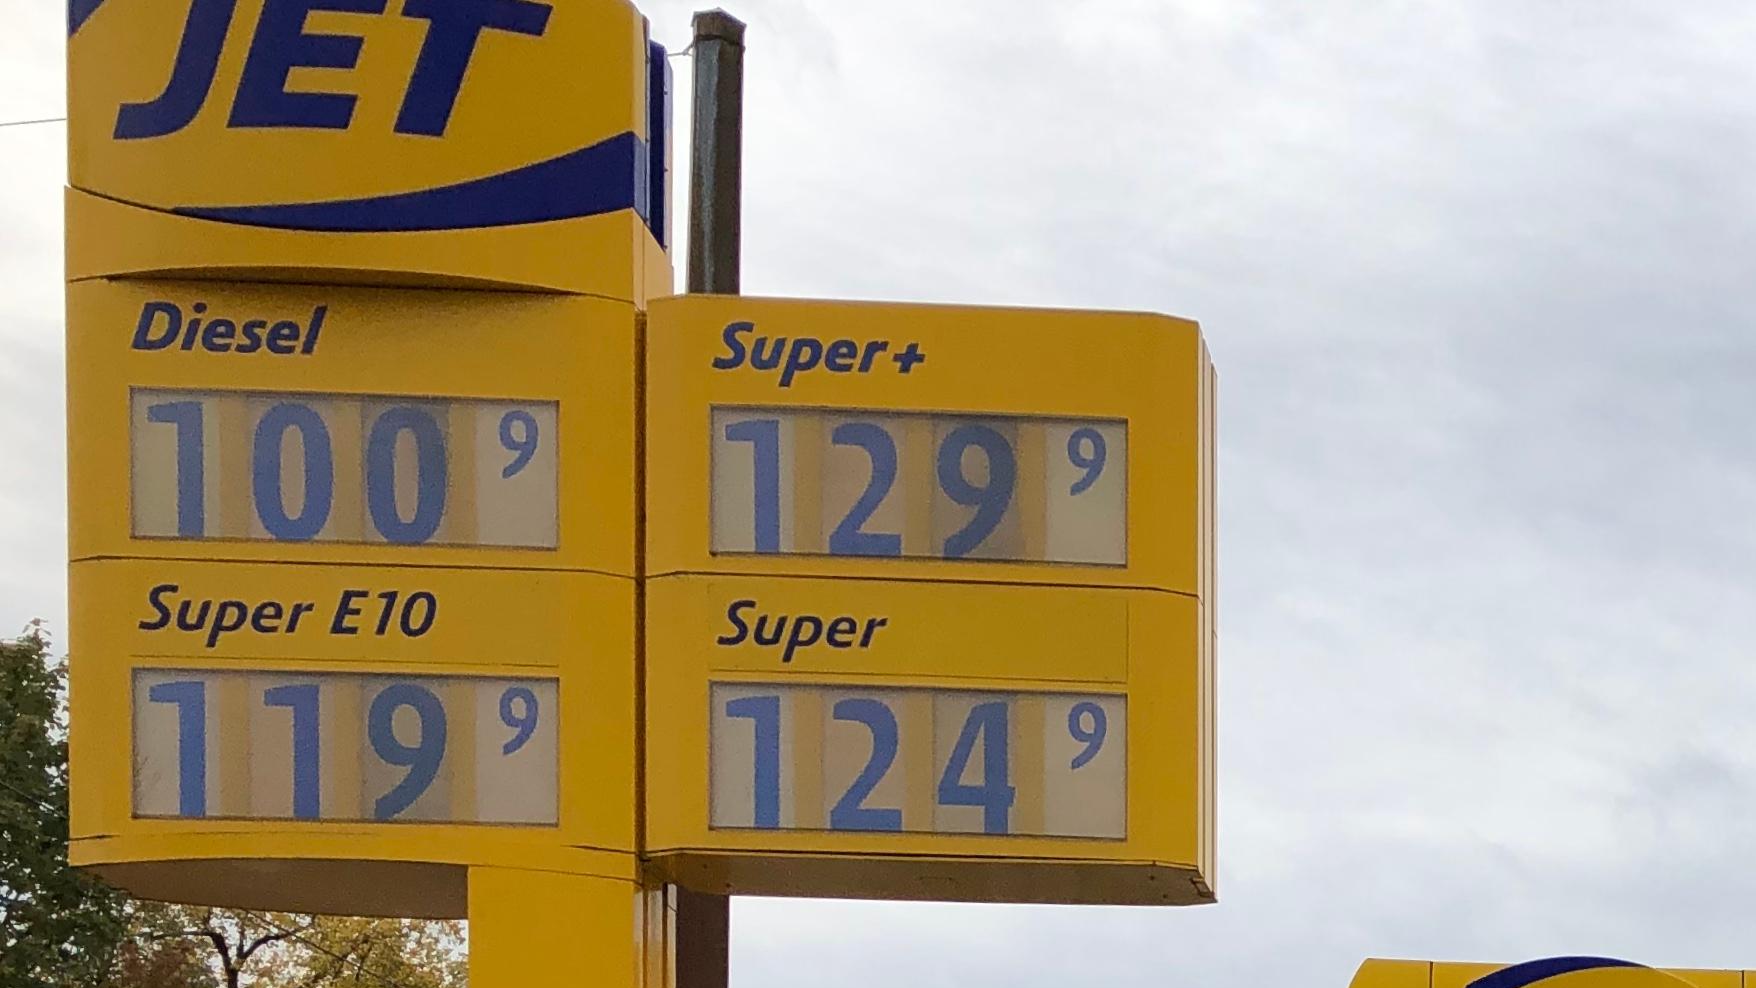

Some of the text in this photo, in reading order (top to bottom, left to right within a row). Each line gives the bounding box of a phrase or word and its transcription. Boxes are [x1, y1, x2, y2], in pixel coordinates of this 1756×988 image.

[113, 0, 554, 140] JET
[131, 301, 328, 355] Diesel
[712, 321, 925, 388] Super+
[138, 583, 437, 648] Super E10
[717, 600, 887, 663] Super
